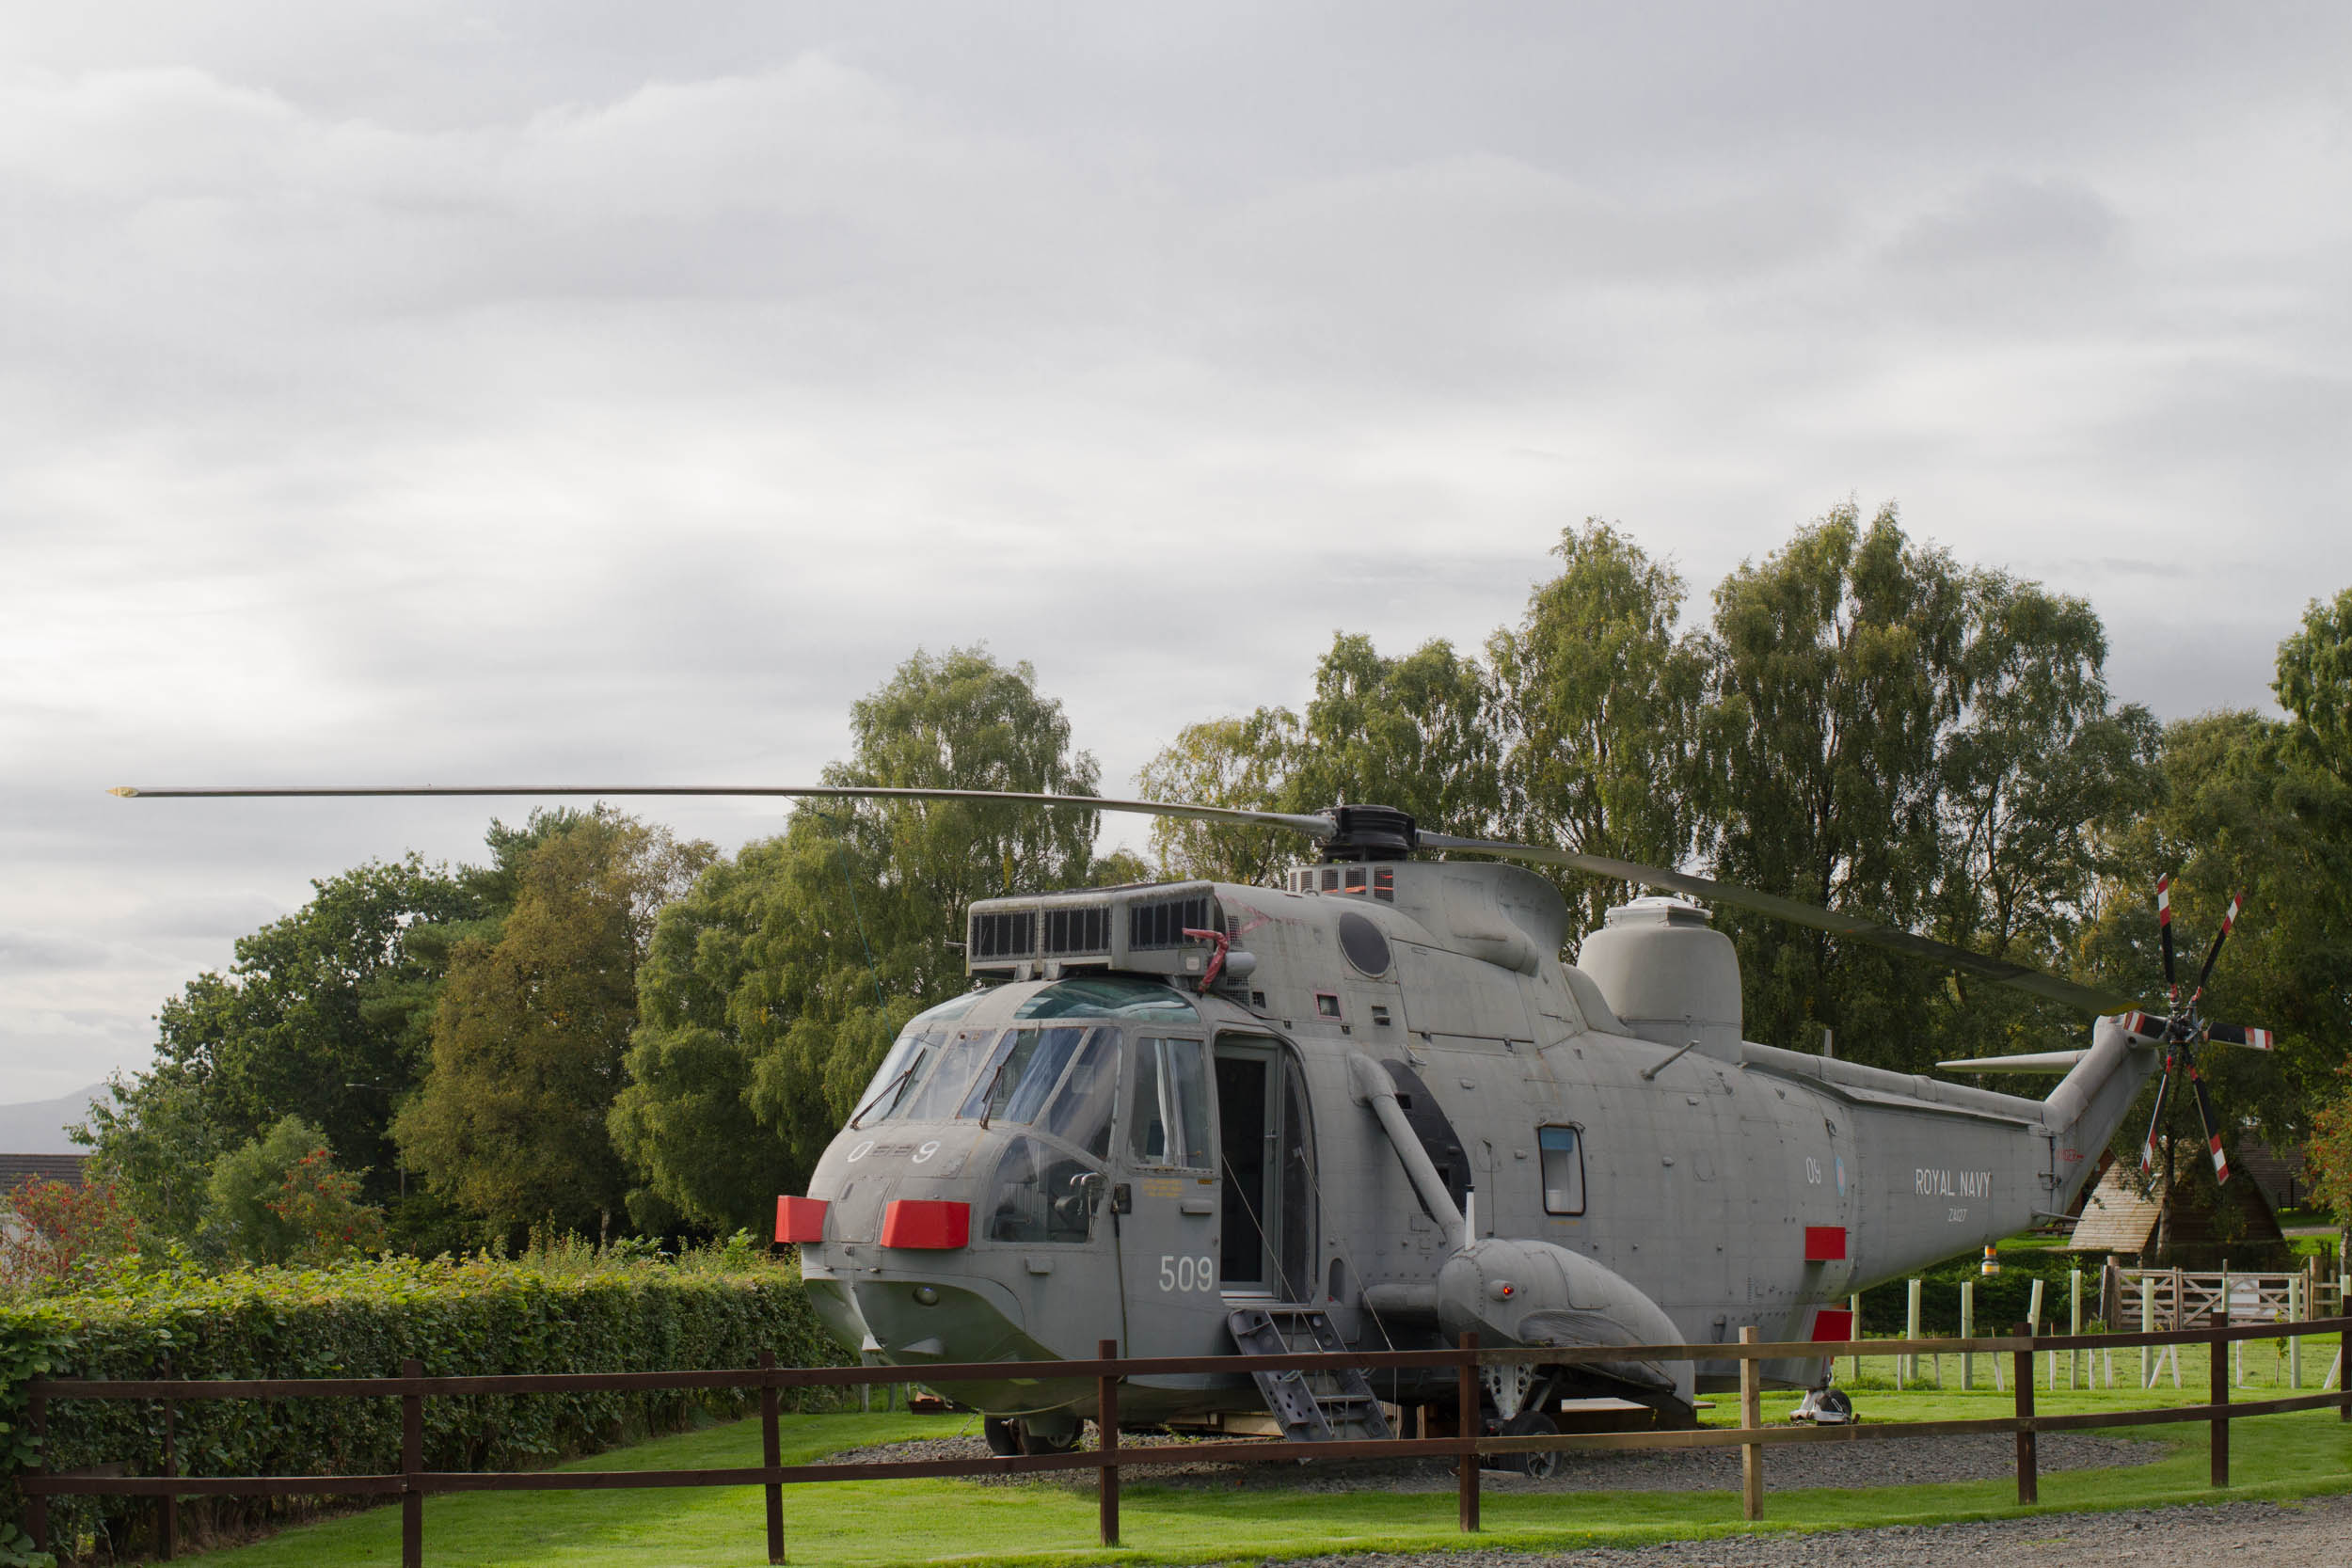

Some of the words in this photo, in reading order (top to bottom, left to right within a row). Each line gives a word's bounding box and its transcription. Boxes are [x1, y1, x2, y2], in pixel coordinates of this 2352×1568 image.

[1805, 1157, 1821, 1184] 09
[1915, 1168, 1956, 1196] ROYAL
[1960, 1171, 1991, 1196] NAVY
[1159, 1256, 1213, 1291] 509
